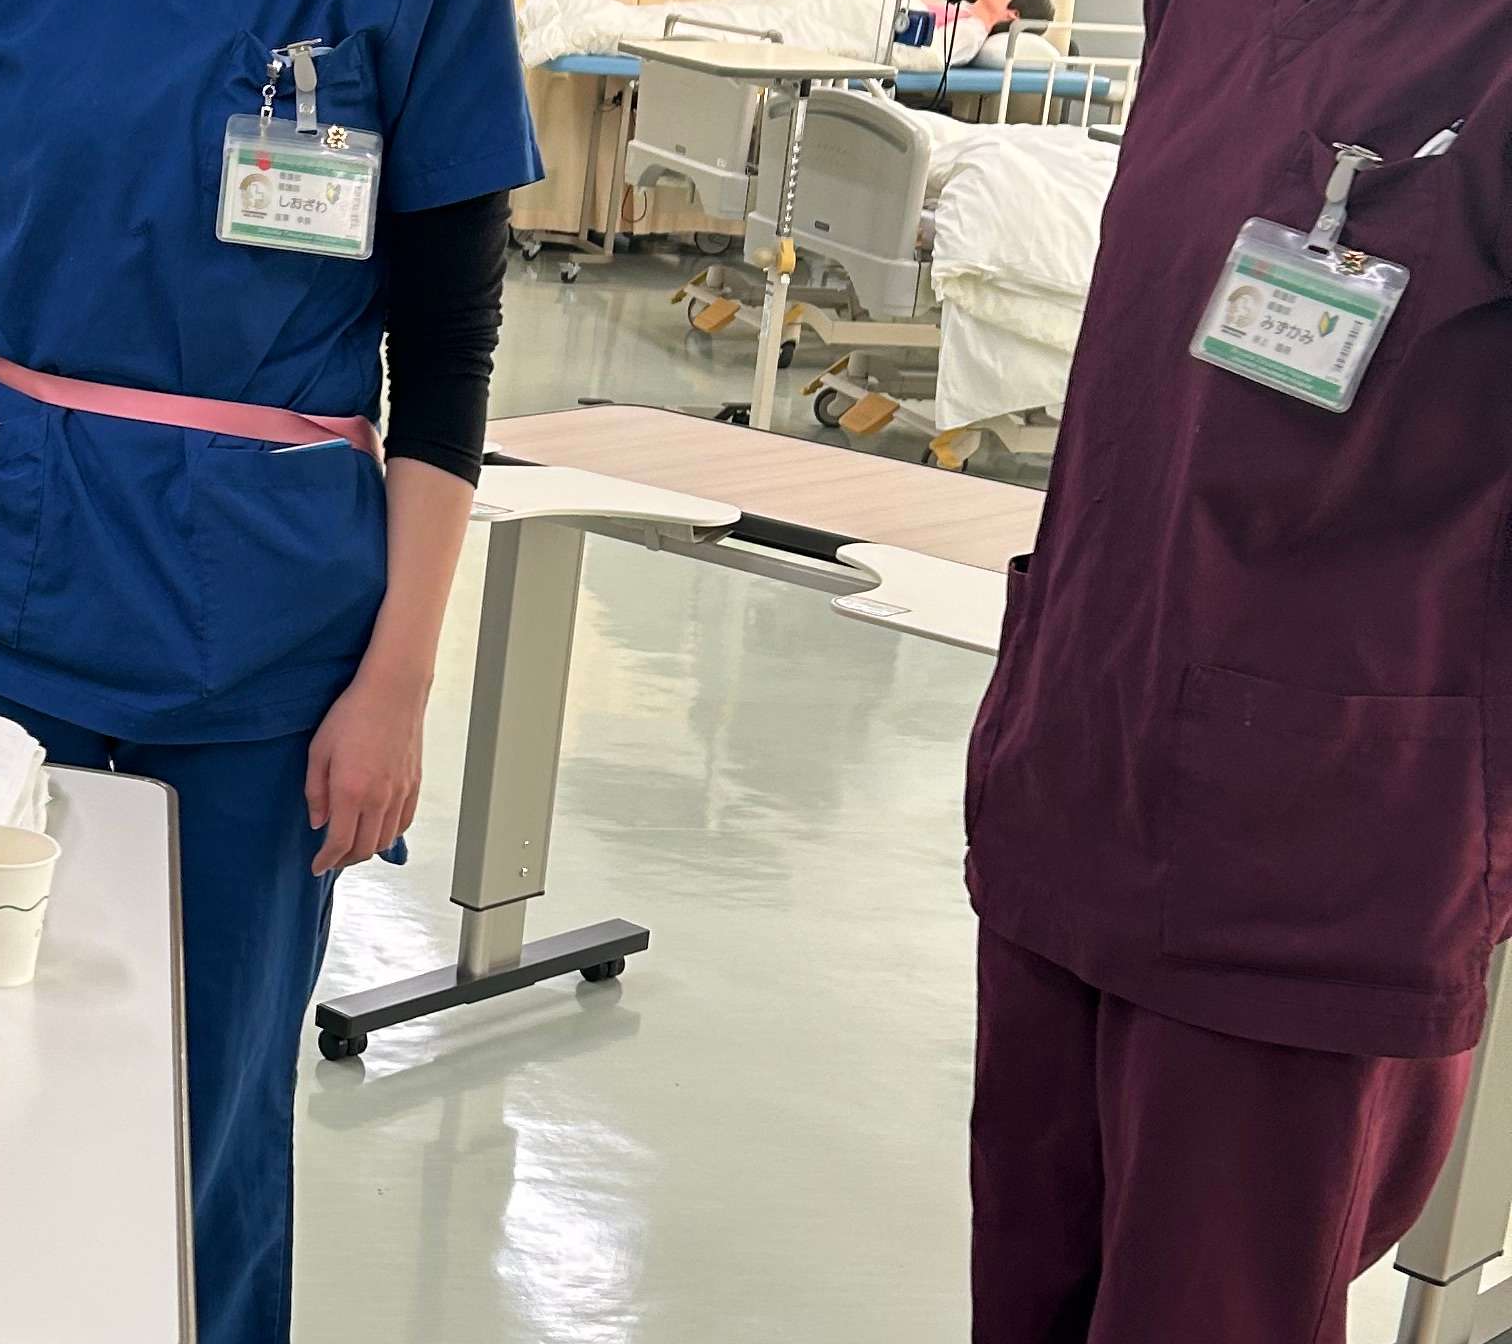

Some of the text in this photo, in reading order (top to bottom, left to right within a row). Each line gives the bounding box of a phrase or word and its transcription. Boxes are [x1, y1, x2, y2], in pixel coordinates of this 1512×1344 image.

[278, 195, 329, 214] しおざわ
[1259, 314, 1315, 346] みずかみ
